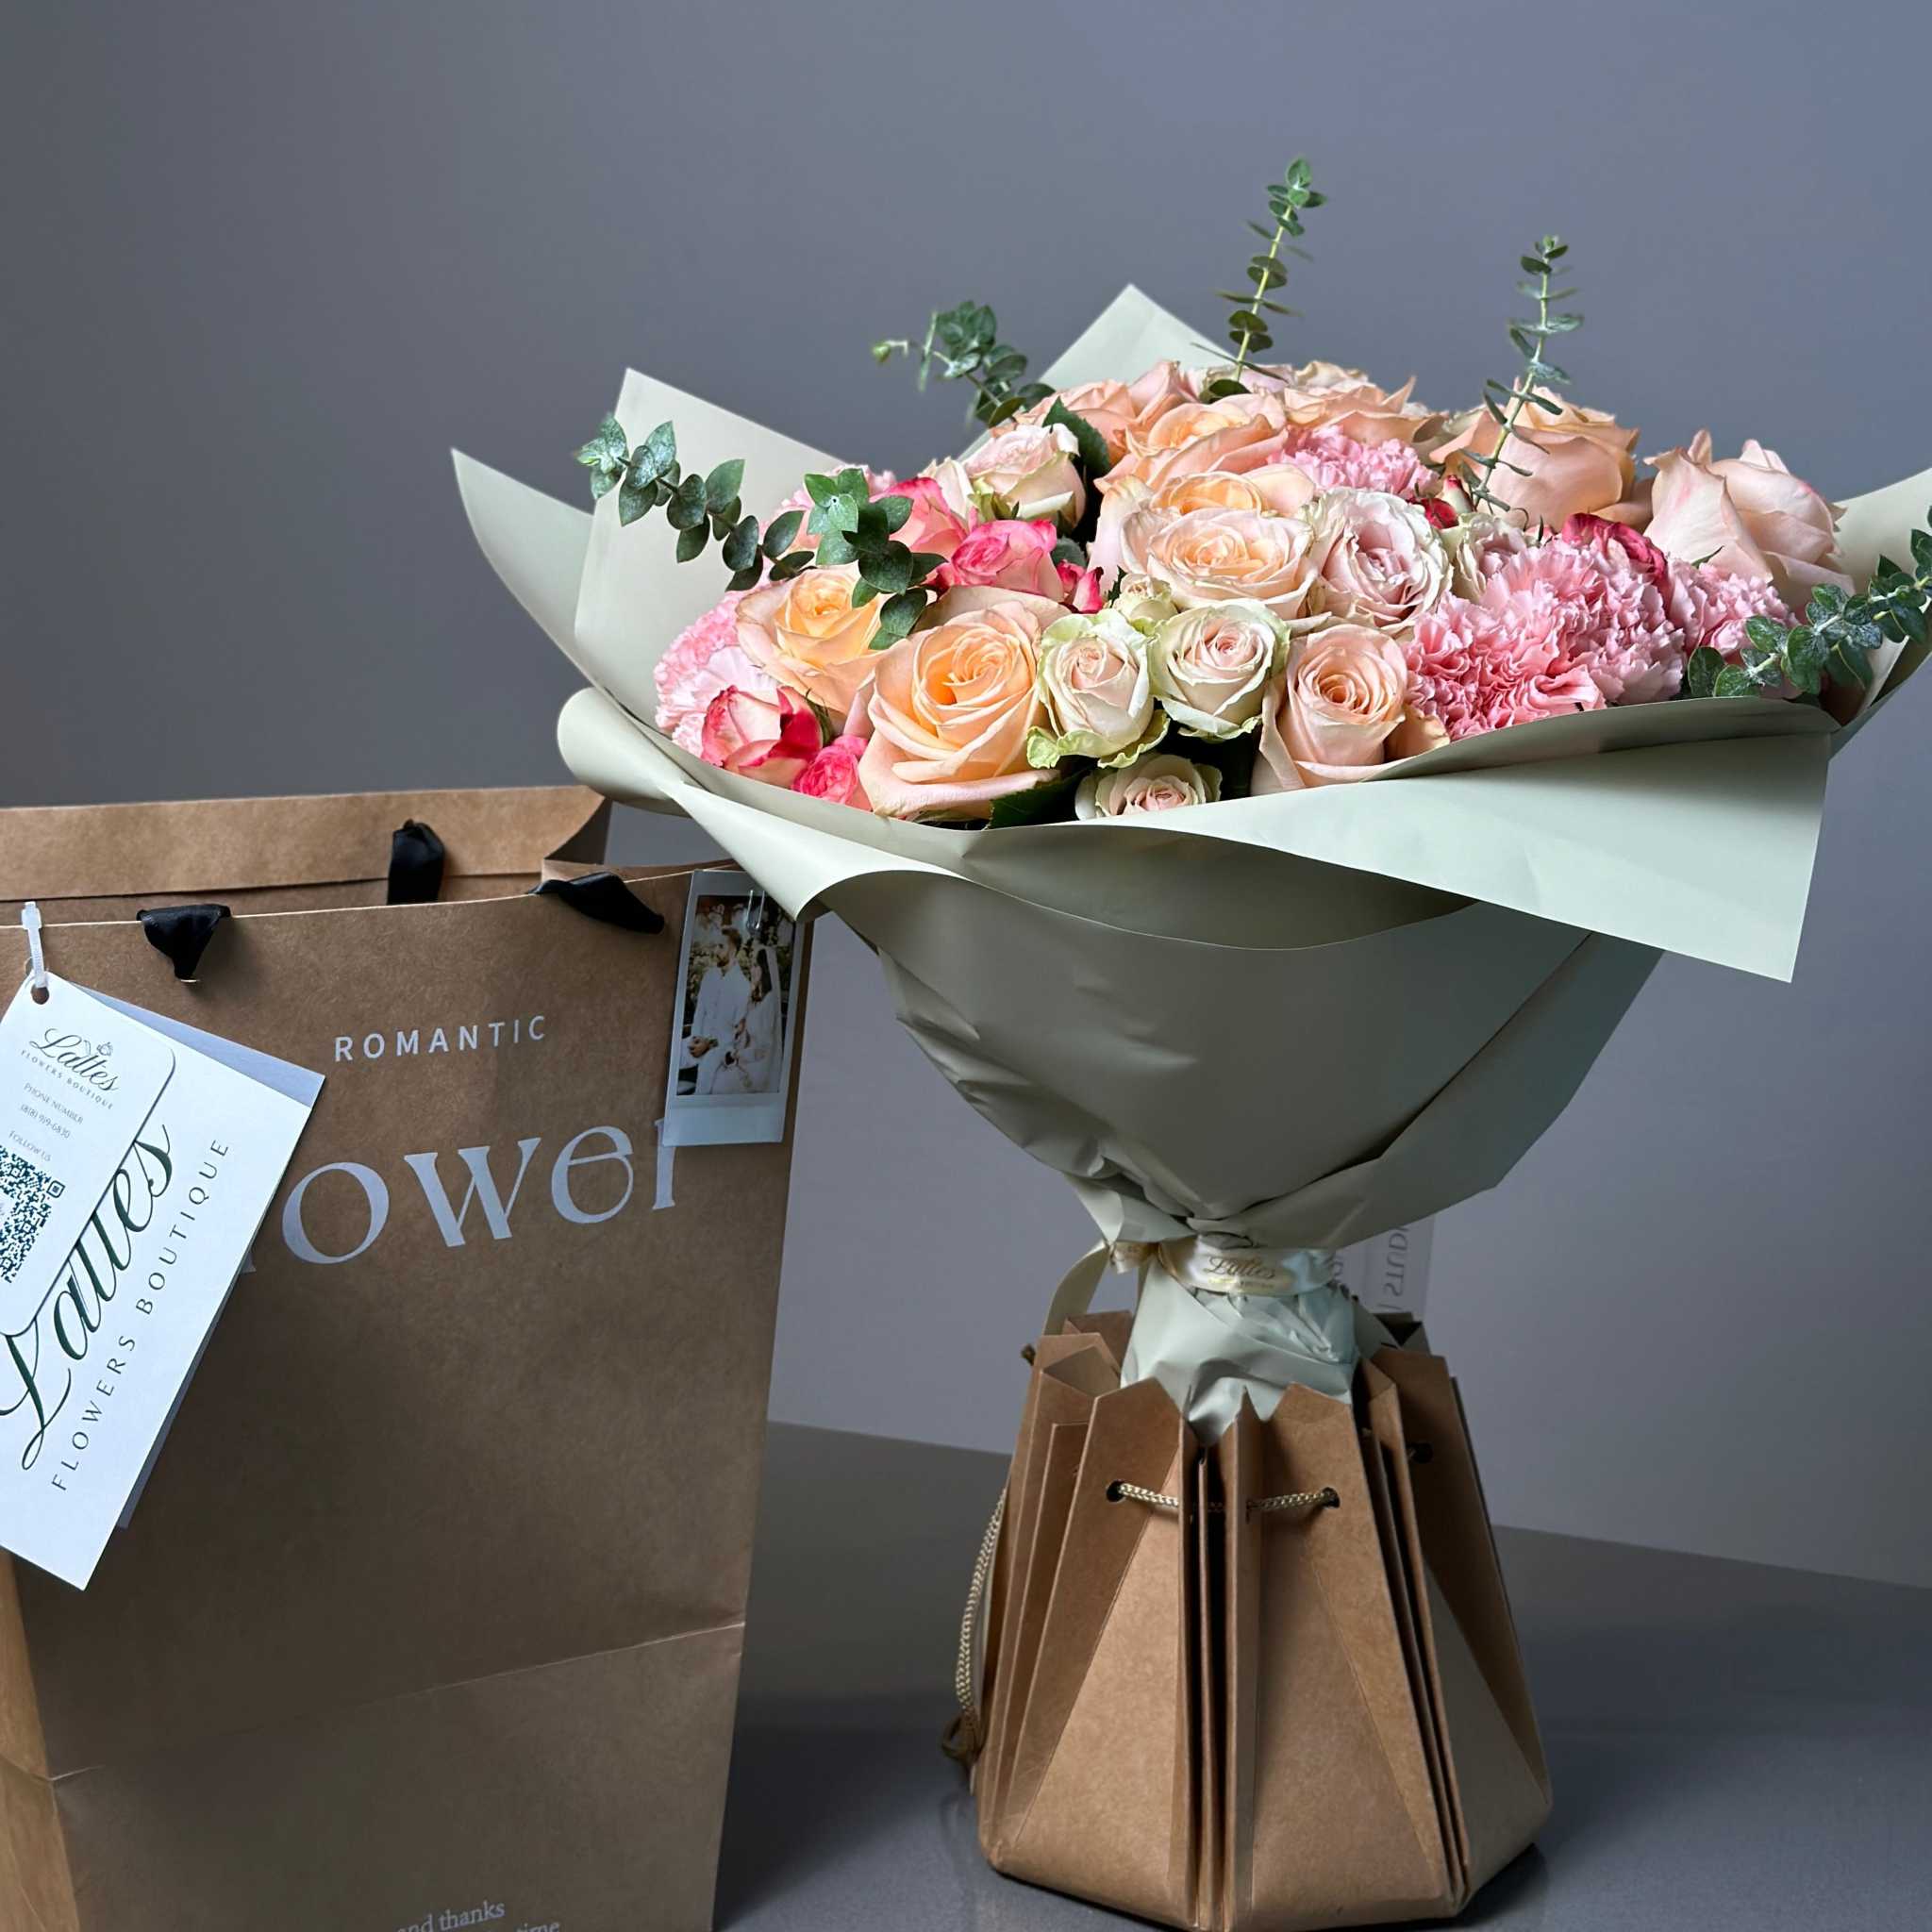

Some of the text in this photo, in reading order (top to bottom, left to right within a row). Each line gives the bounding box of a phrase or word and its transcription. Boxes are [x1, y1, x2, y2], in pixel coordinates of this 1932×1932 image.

[29, 1027, 119, 1091] Lattes
[334, 1015, 546, 1062] ROMANTIC
[21, 1049, 114, 1110] FLOWERS BOUTIQUE
[24, 1083, 84, 1125] PHONE NUMBER
[8, 1130, 52, 1162] FOLLOW US
[52, 1139, 229, 1491] FLOWERS BOUTIQUE
[439, 1900, 506, 1931] thanks
